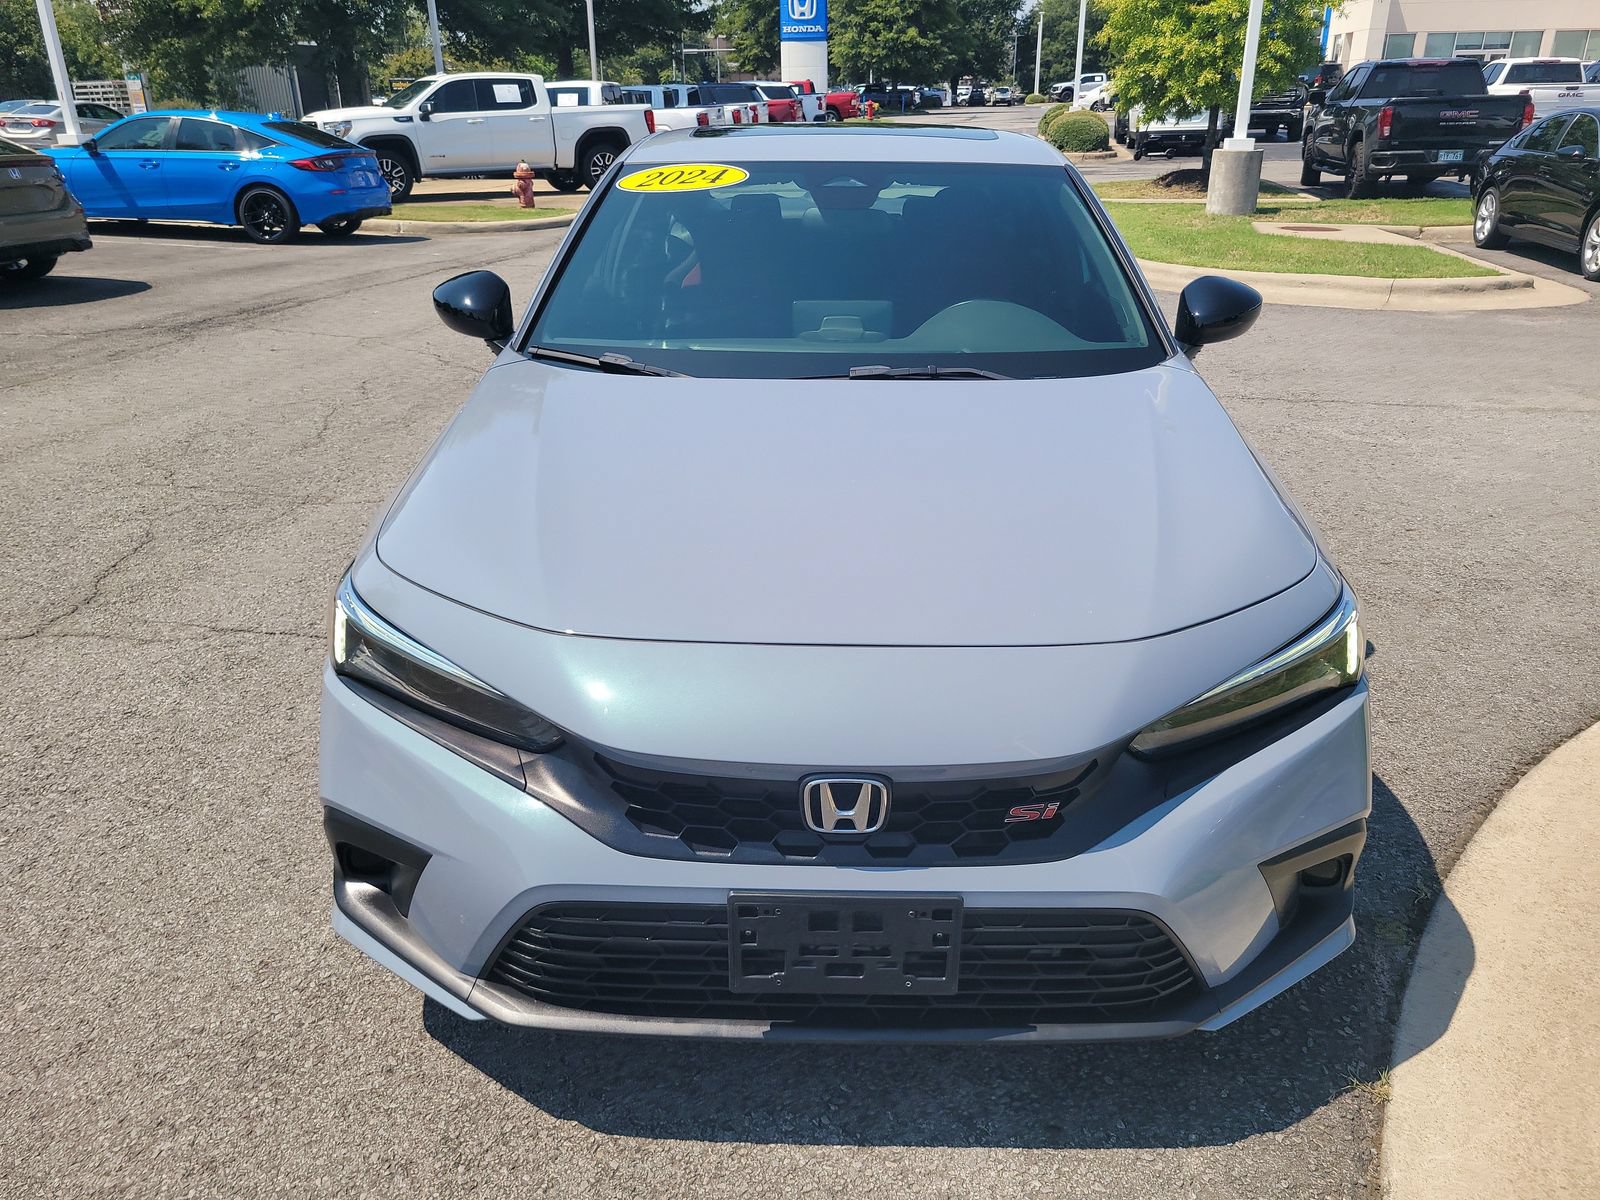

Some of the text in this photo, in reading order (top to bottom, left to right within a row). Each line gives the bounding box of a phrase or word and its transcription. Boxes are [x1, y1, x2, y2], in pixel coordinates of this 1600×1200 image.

[782, 25, 825, 33] HONDA
[1439, 110, 1480, 119] GMC
[634, 168, 730, 188] 2024
[1004, 802, 1061, 823] Si
